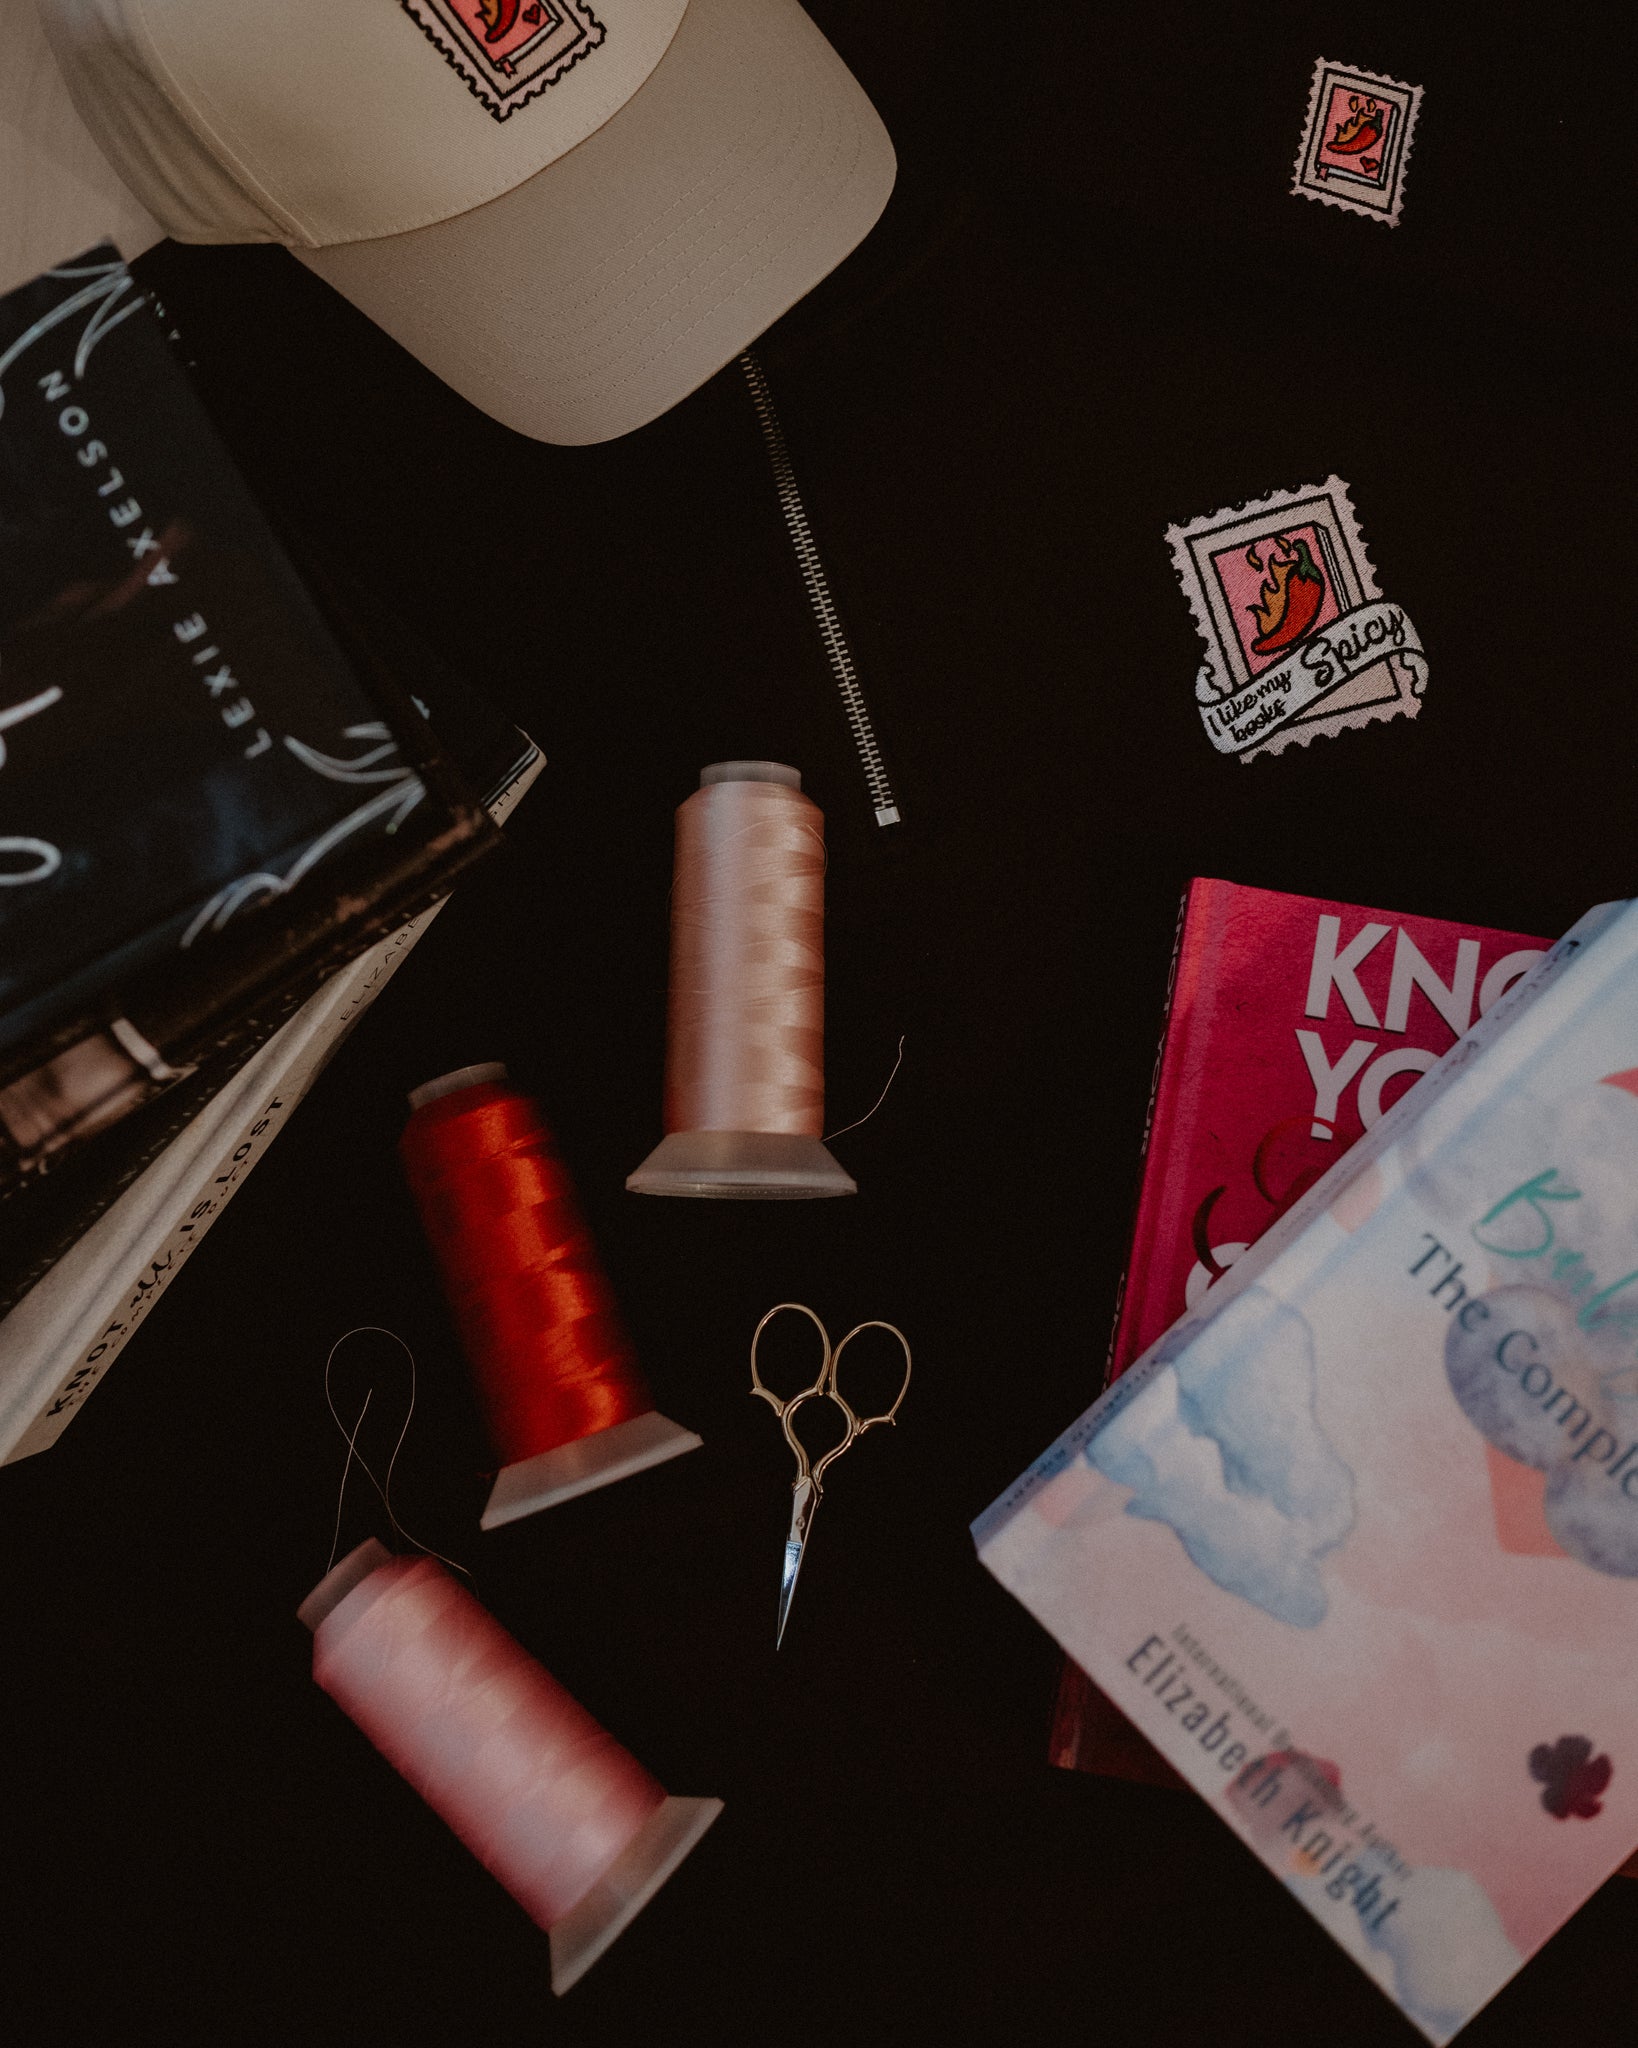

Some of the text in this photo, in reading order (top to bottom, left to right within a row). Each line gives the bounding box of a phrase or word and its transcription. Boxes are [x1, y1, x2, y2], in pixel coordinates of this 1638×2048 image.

[37, 368, 181, 588] AXELSON
[173, 610, 274, 761] LEXIE
[1207, 609, 1405, 737] I like my Spicy
[1229, 698, 1287, 744] books
[1304, 914, 1553, 1041] KN
[46, 1320, 125, 1418] KNOT
[179, 1199, 212, 1233] IS
[215, 1096, 284, 1184] LOST
[1408, 1232, 1492, 1333] The
[1125, 1633, 1288, 1809] Elizabeth
[1280, 1799, 1401, 1937] Knight
